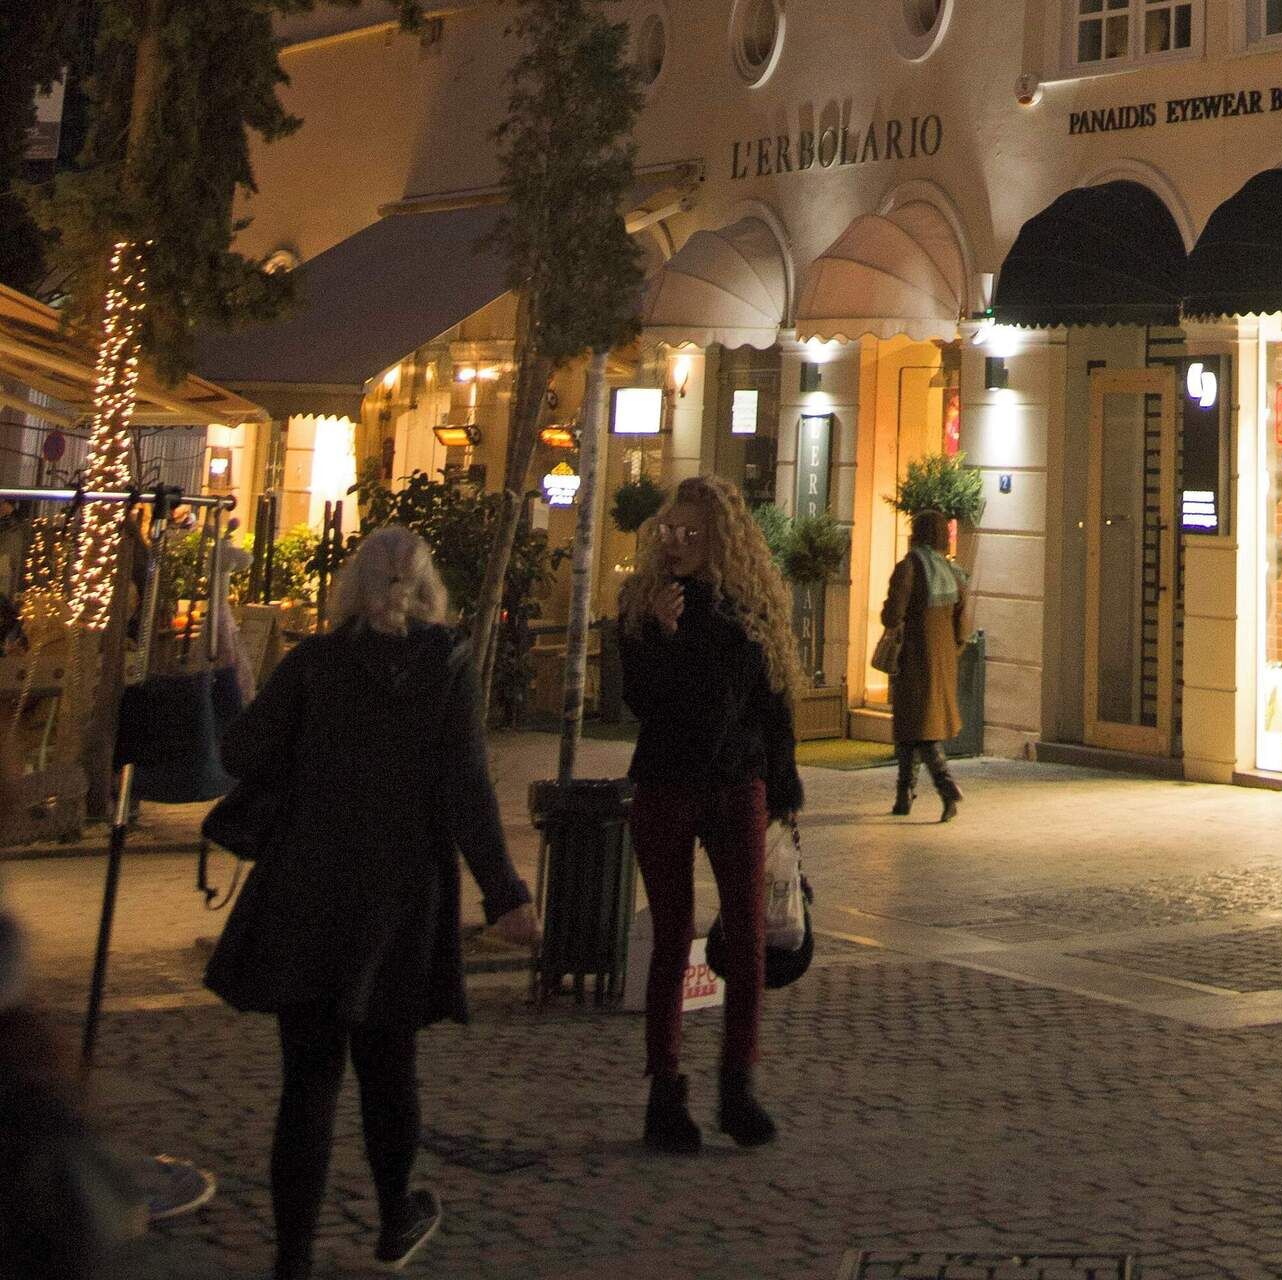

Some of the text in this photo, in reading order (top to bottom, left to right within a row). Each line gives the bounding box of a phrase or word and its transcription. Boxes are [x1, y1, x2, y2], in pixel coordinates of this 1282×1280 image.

[1069, 103, 1156, 134] PANAIDIS
[1166, 91, 1264, 124] EYEWEAR
[730, 114, 943, 179] L'ERBOLARIO
